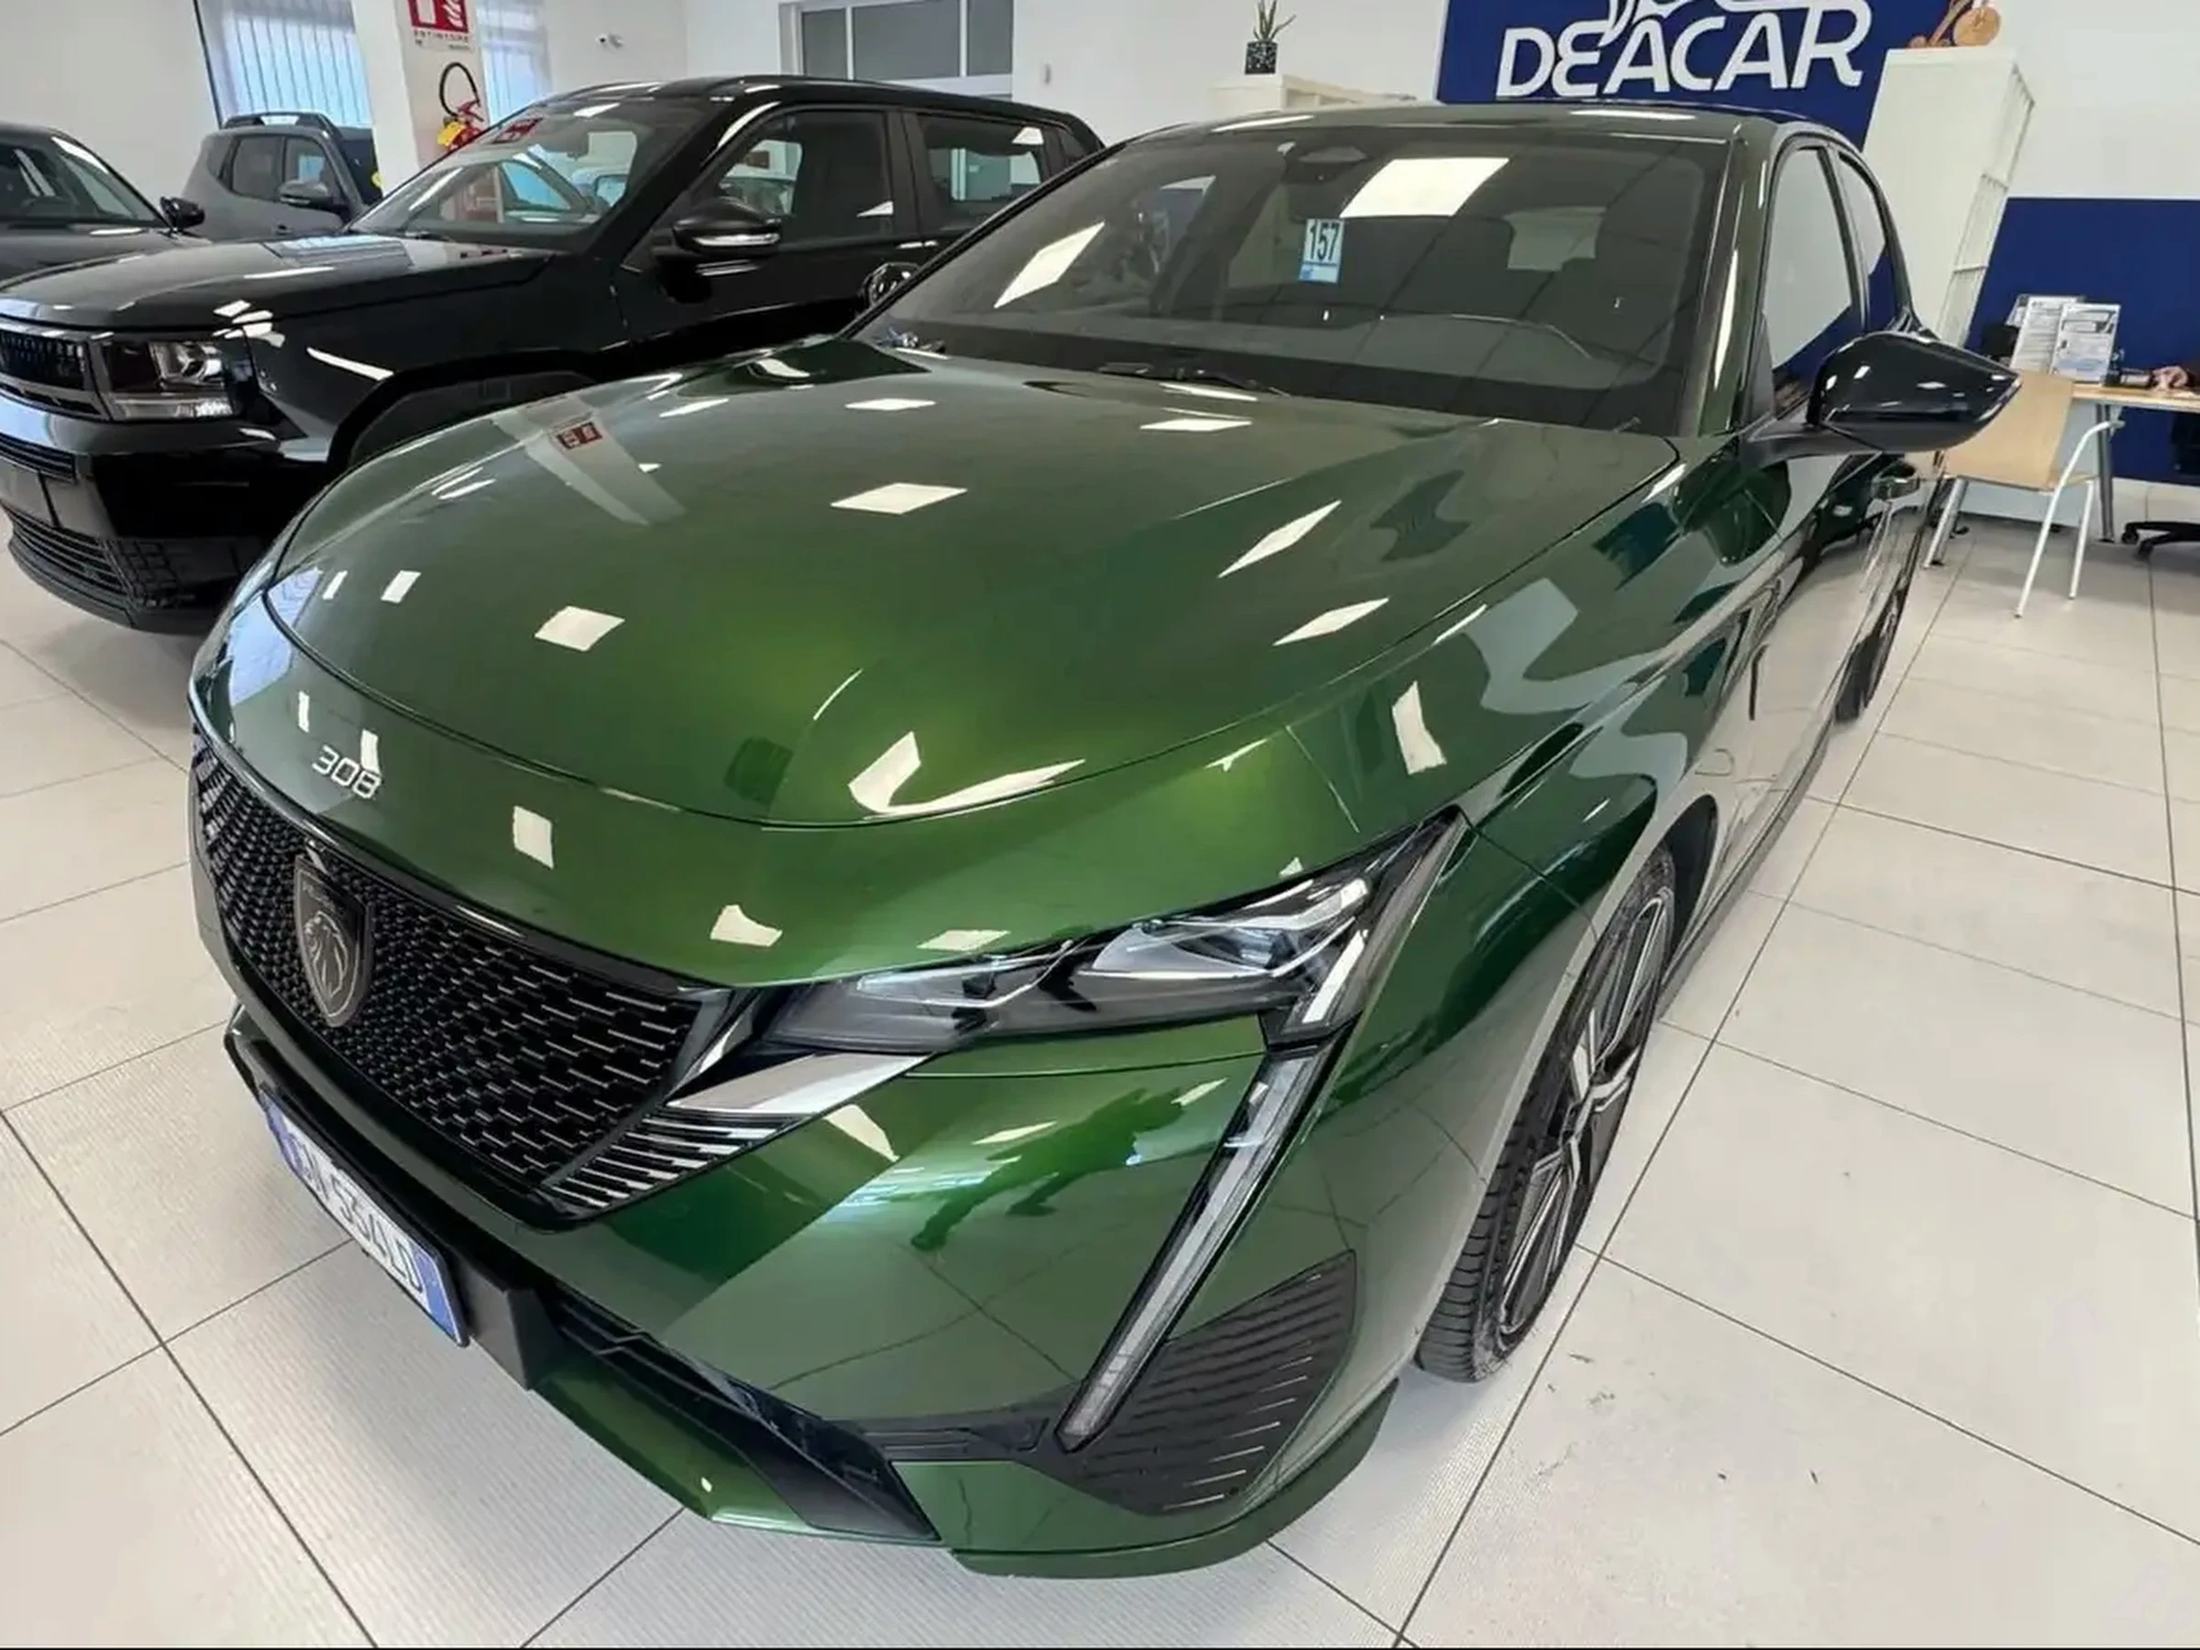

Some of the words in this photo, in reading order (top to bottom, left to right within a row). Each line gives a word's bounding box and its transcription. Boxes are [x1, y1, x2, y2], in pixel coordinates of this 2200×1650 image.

[1495, 1, 1872, 98] DEACAR
[1309, 221, 1340, 261] 157
[312, 745, 382, 799] 308
